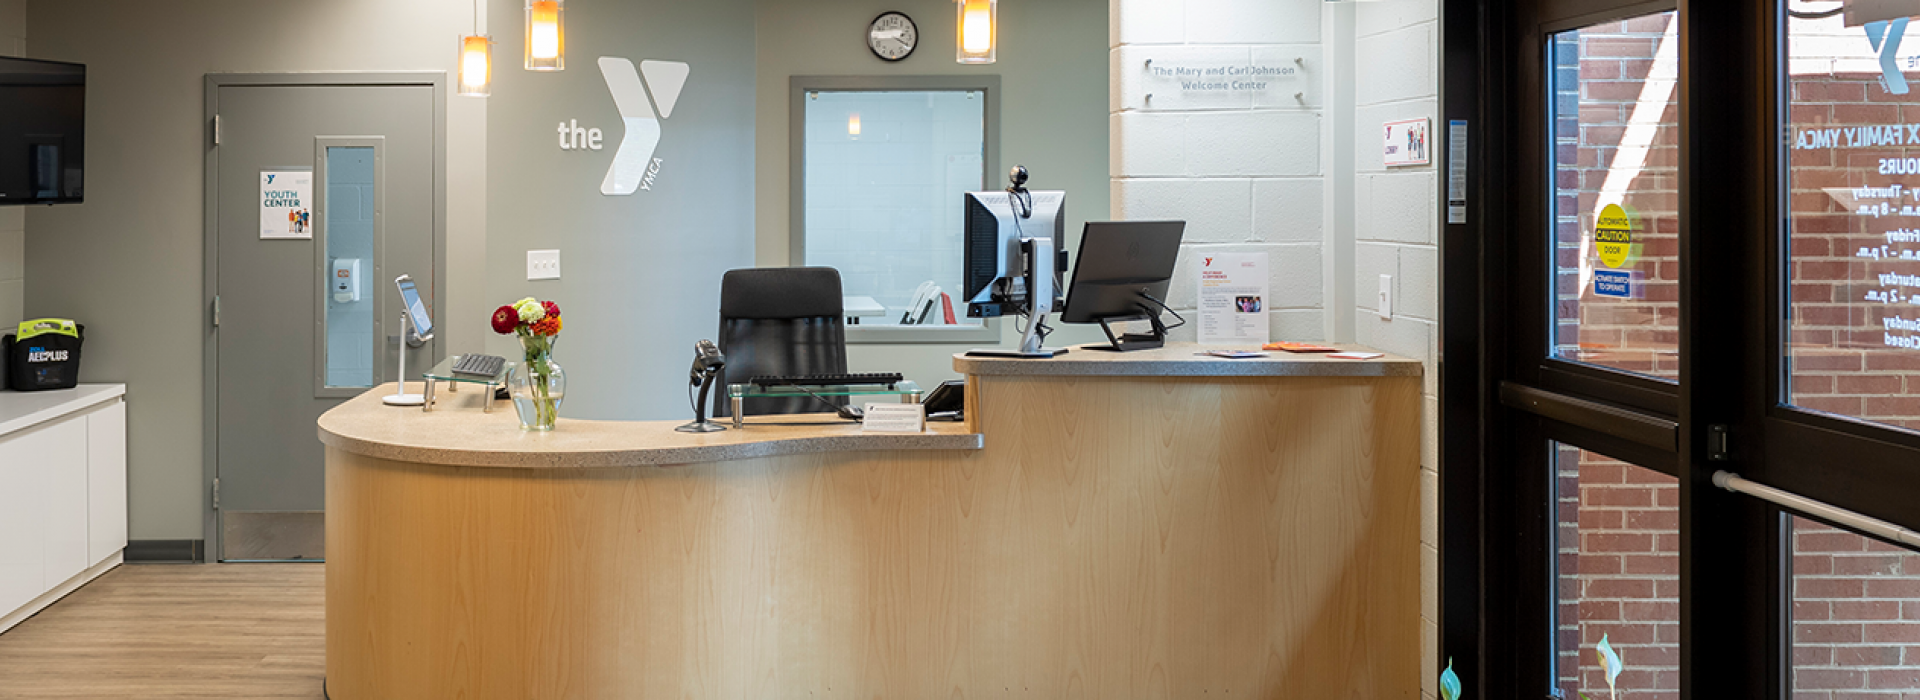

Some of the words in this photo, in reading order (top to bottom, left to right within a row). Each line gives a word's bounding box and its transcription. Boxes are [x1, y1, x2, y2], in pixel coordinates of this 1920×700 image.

[1153, 66, 1173, 76] The
[1175, 66, 1202, 77] Mary
[1205, 66, 1225, 76] and
[1228, 66, 1249, 76] Carl
[1251, 66, 1295, 76] Johnson
[1181, 81, 1229, 90] Welcome
[1231, 81, 1267, 90] Center
[558, 118, 603, 150] the
[597, 56, 690, 195] Y
[640, 157, 664, 191] YMCA
[264, 191, 298, 199] YOUTH
[264, 199, 301, 208] CENTER
[1597, 217, 1628, 226] AUTOMATIC
[1596, 230, 1630, 242] CAUTION
[1604, 246, 1621, 255] DOOR
